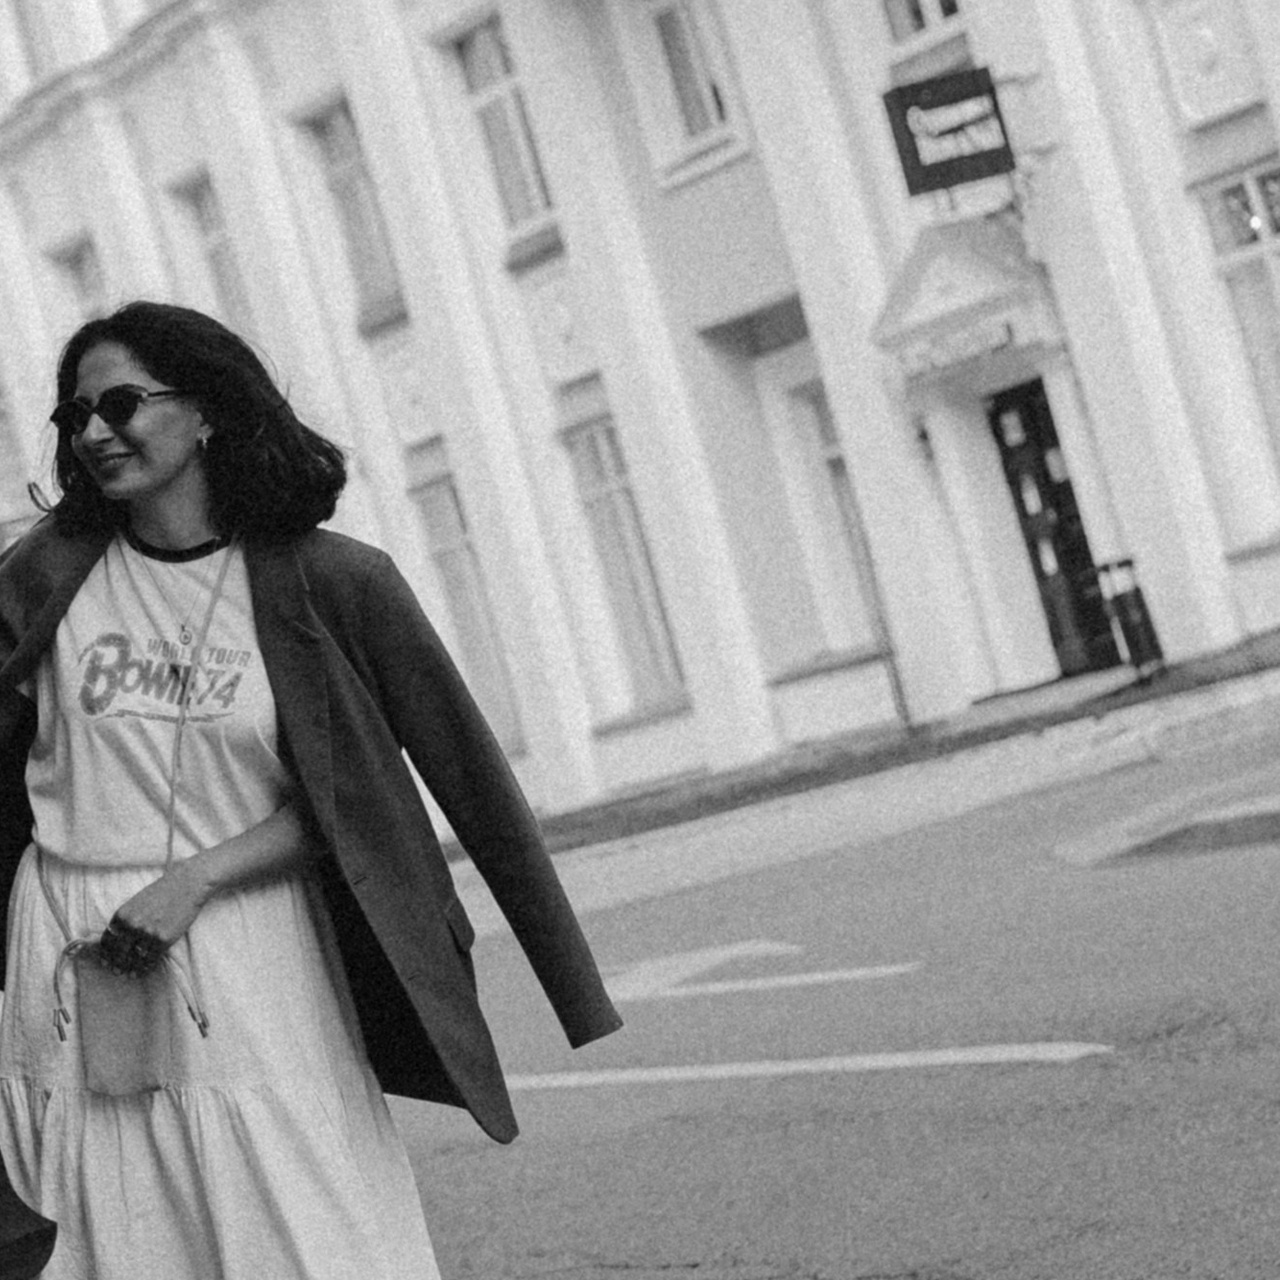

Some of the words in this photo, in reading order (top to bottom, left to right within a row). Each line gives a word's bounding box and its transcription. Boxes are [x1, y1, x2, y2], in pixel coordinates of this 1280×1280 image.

[146, 637, 194, 662] WORL
[207, 646, 252, 668] TOUR
[196, 669, 243, 709] 74
